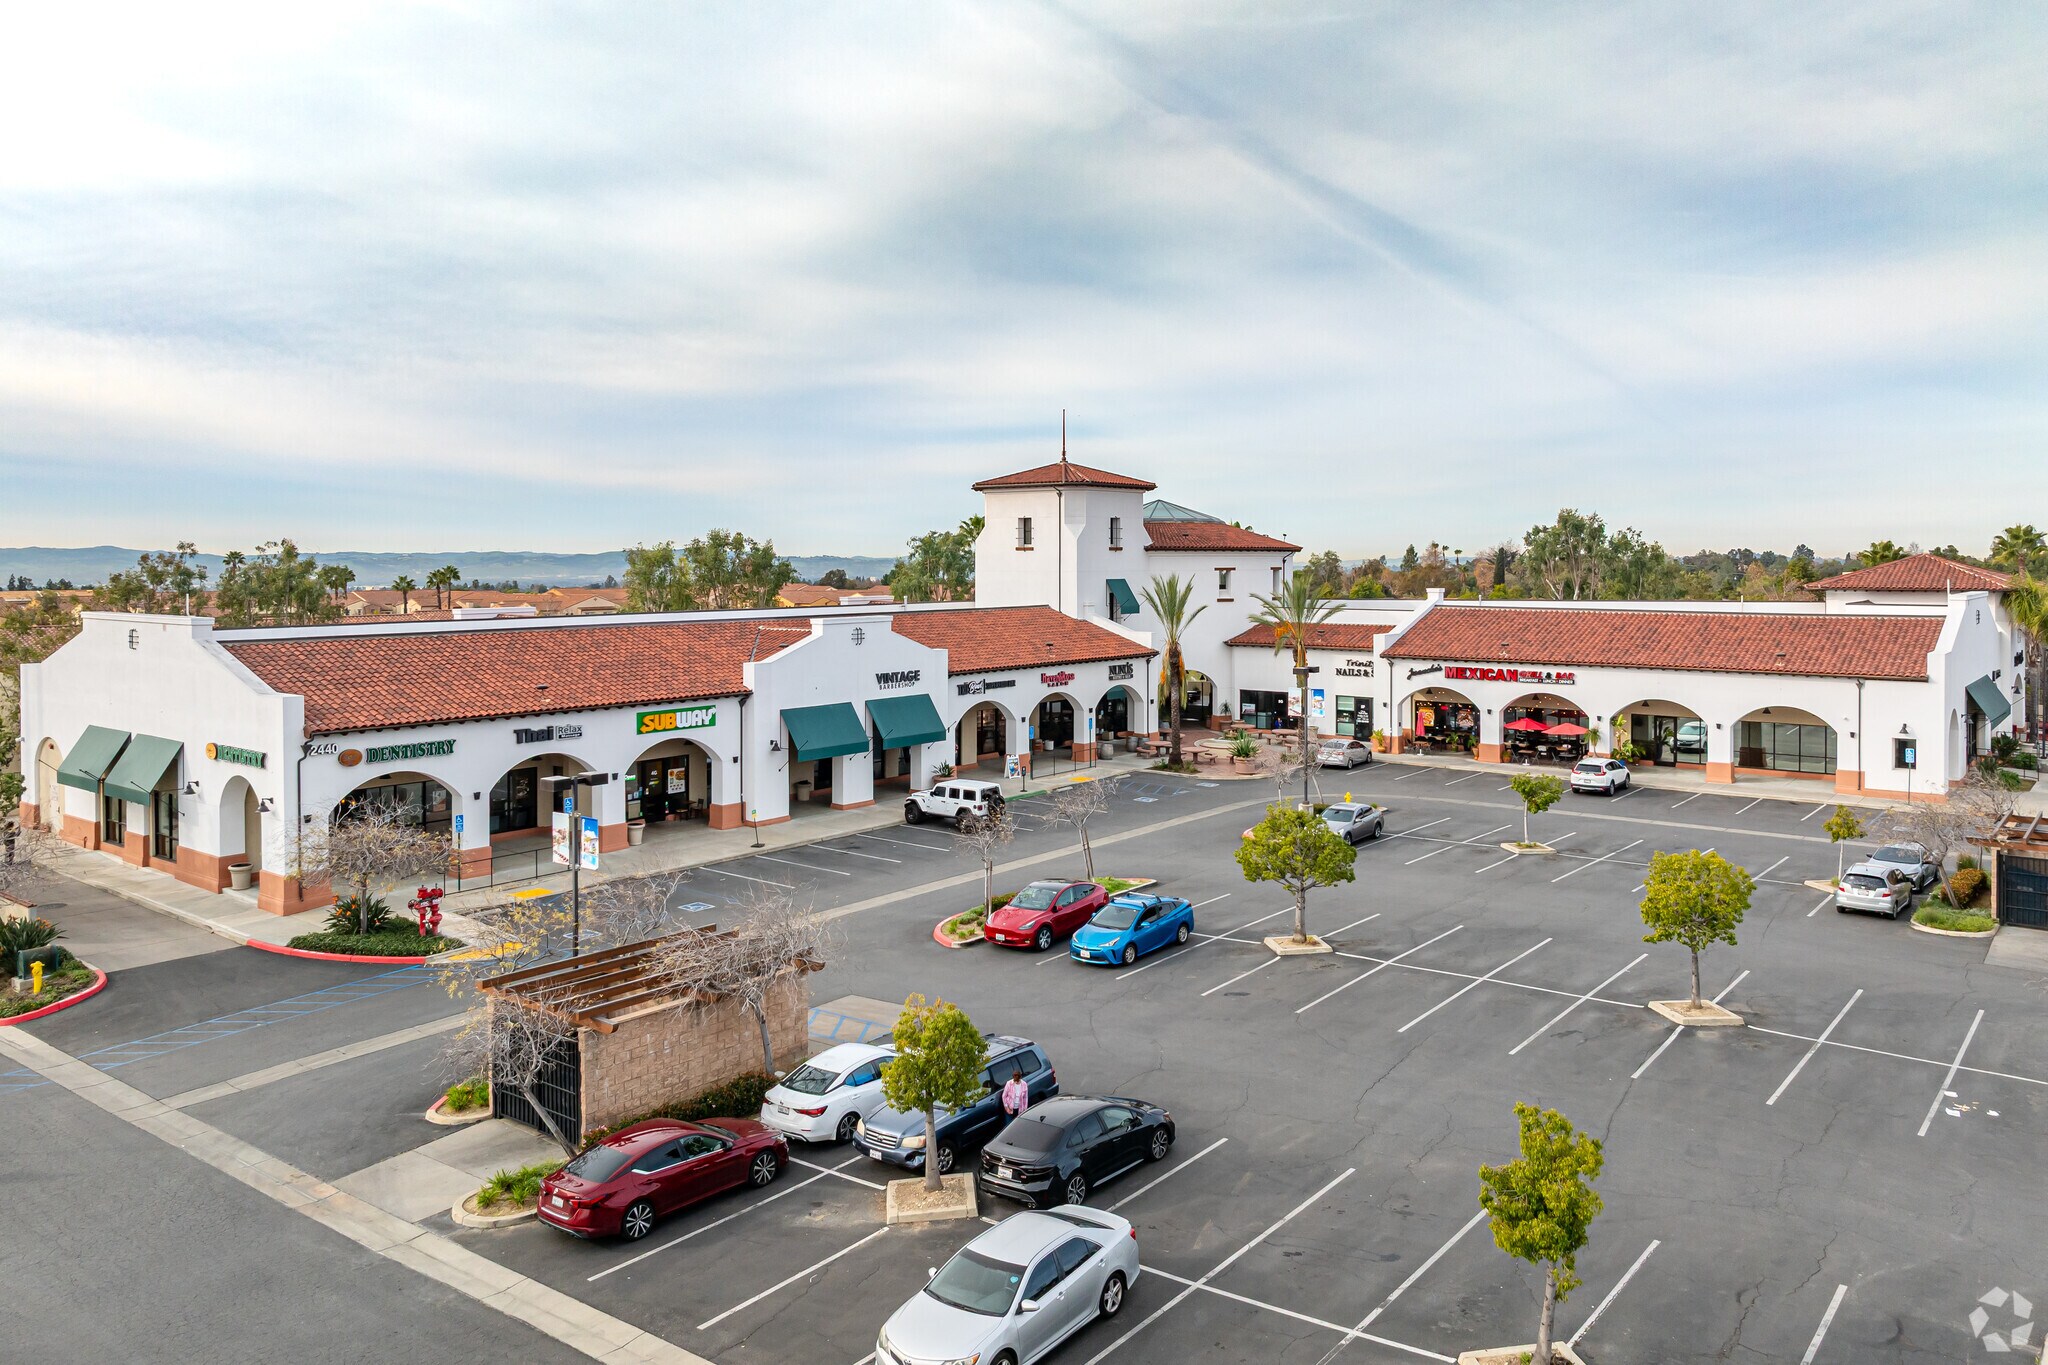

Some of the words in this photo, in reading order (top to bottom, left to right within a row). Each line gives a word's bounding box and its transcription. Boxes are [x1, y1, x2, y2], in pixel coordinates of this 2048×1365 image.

[875, 669, 920, 684] VINTAGE
[1335, 667, 1361, 676] NAILS
[1363, 669, 1370, 677] &
[1445, 666, 1519, 682] MEXICAN
[1519, 671, 1543, 679] GRILL
[1555, 672, 1575, 680] BAR
[879, 681, 915, 690] BARBERSHOP
[640, 707, 717, 733] SUBWAY
[513, 726, 554, 744] Thai
[557, 724, 582, 734] Relax
[218, 745, 267, 769] DENTISTRY
[310, 743, 339, 756] 2440
[366, 739, 456, 764] DENTISTRY
